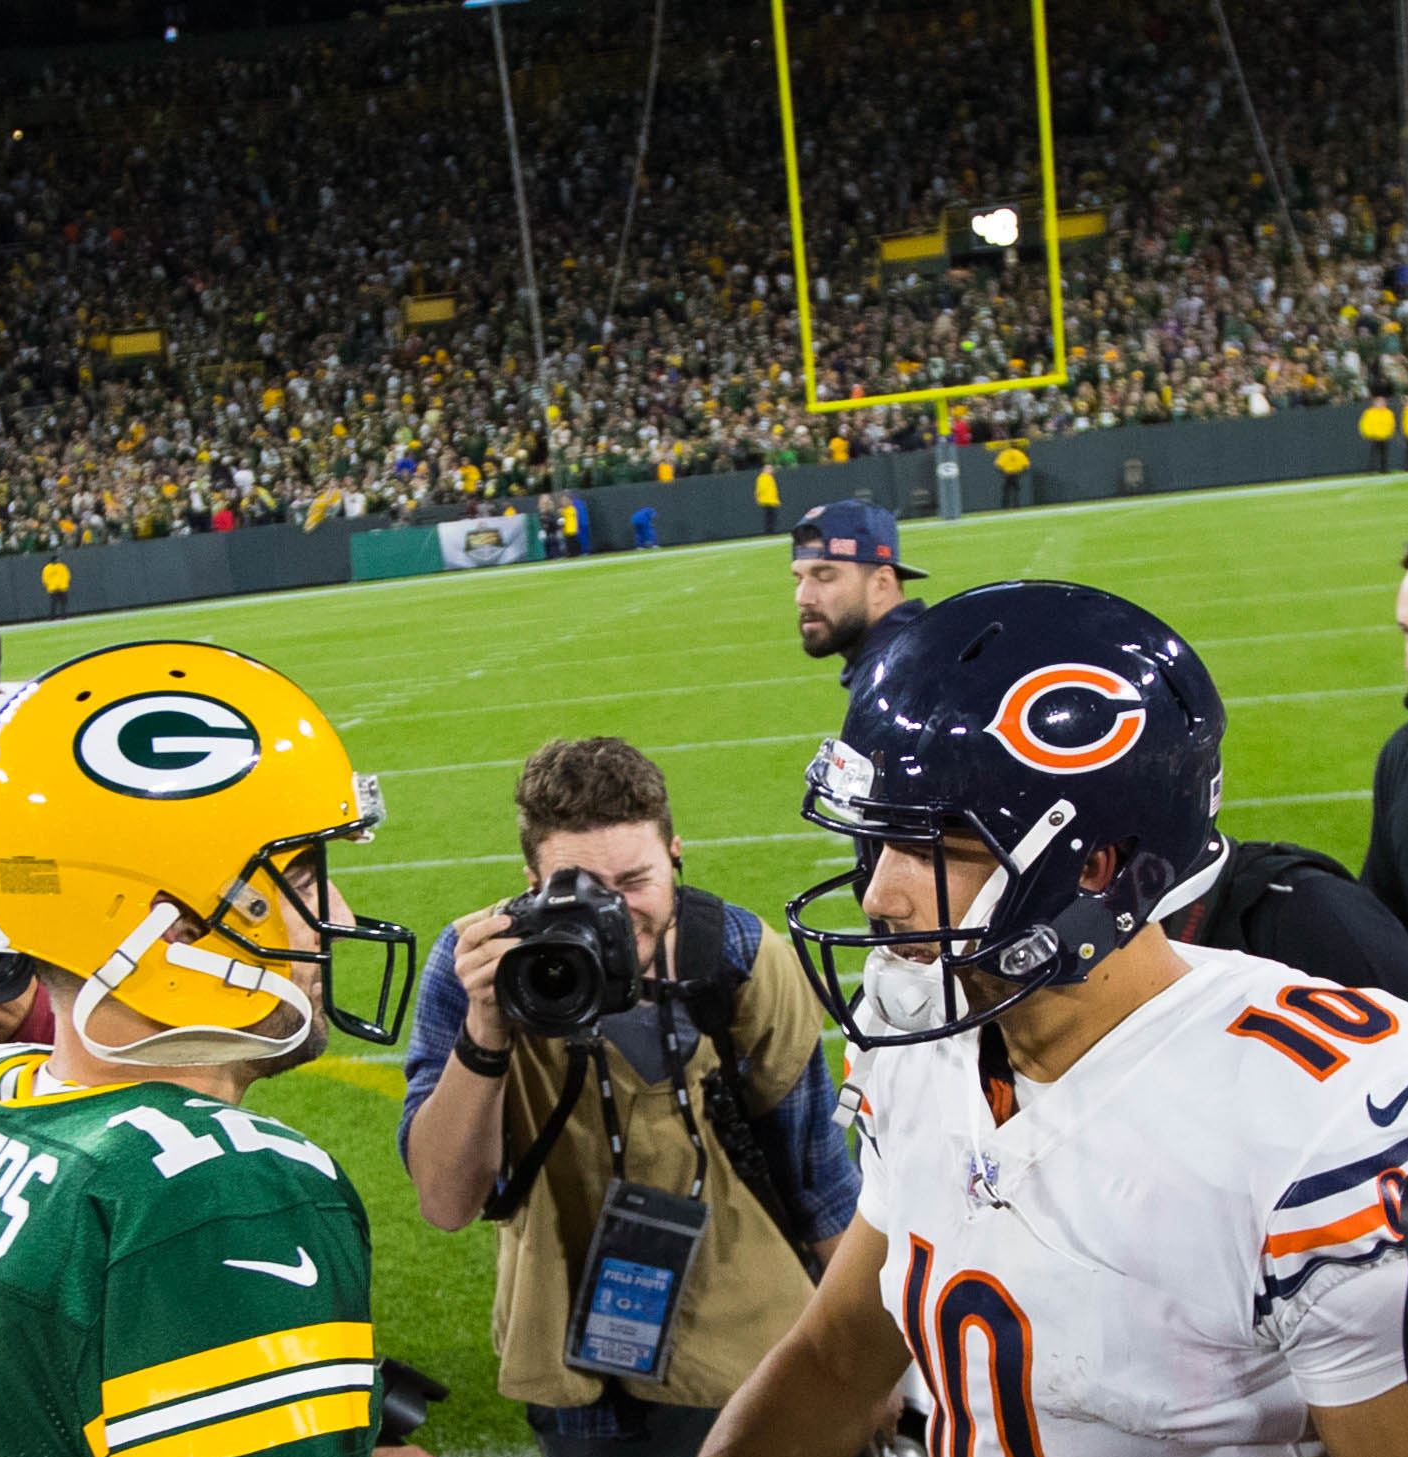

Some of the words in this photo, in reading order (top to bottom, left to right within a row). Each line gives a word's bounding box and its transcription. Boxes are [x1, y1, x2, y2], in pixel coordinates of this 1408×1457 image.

[75, 693, 260, 799] G
[983, 663, 1146, 775] C
[1226, 985, 1401, 1083] 10
[107, 1098, 337, 1181] 12
